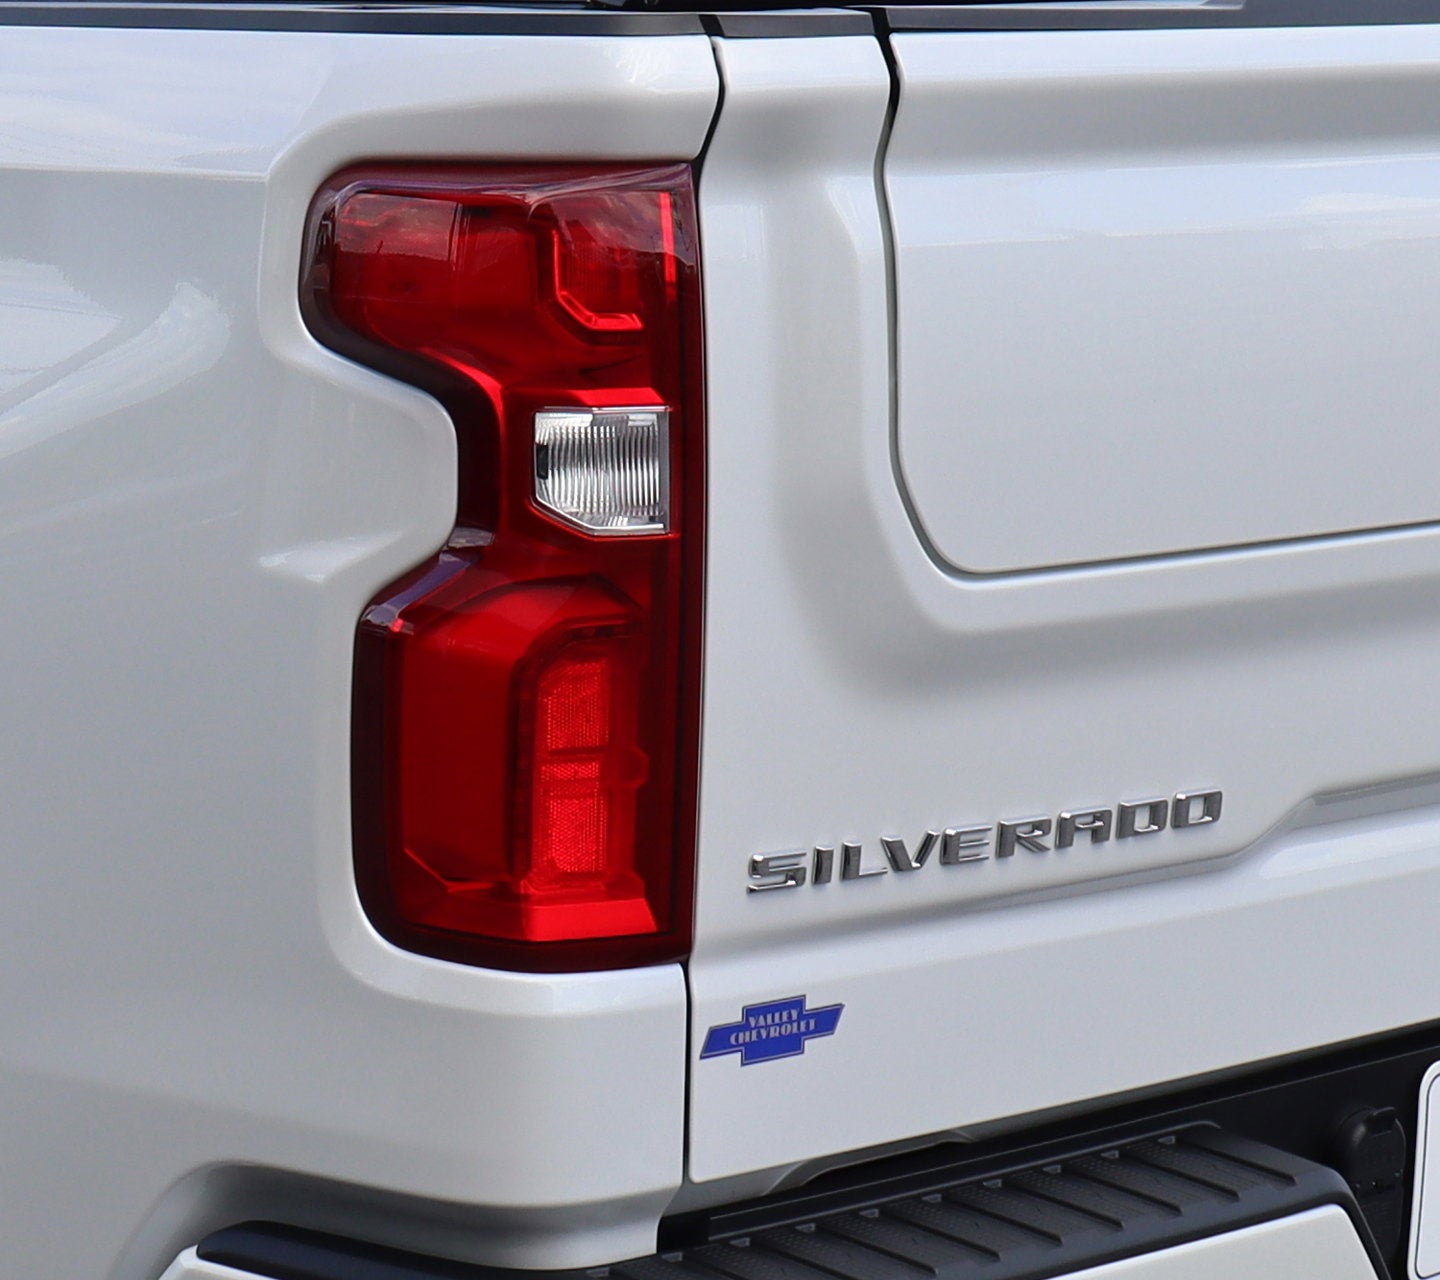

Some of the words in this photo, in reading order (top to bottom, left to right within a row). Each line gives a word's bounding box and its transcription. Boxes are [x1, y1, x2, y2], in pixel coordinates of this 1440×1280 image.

[745, 786, 1224, 895] SILVERADO
[729, 1018, 817, 1046] CHEVROLET
[748, 1007, 799, 1029] VALLEY
